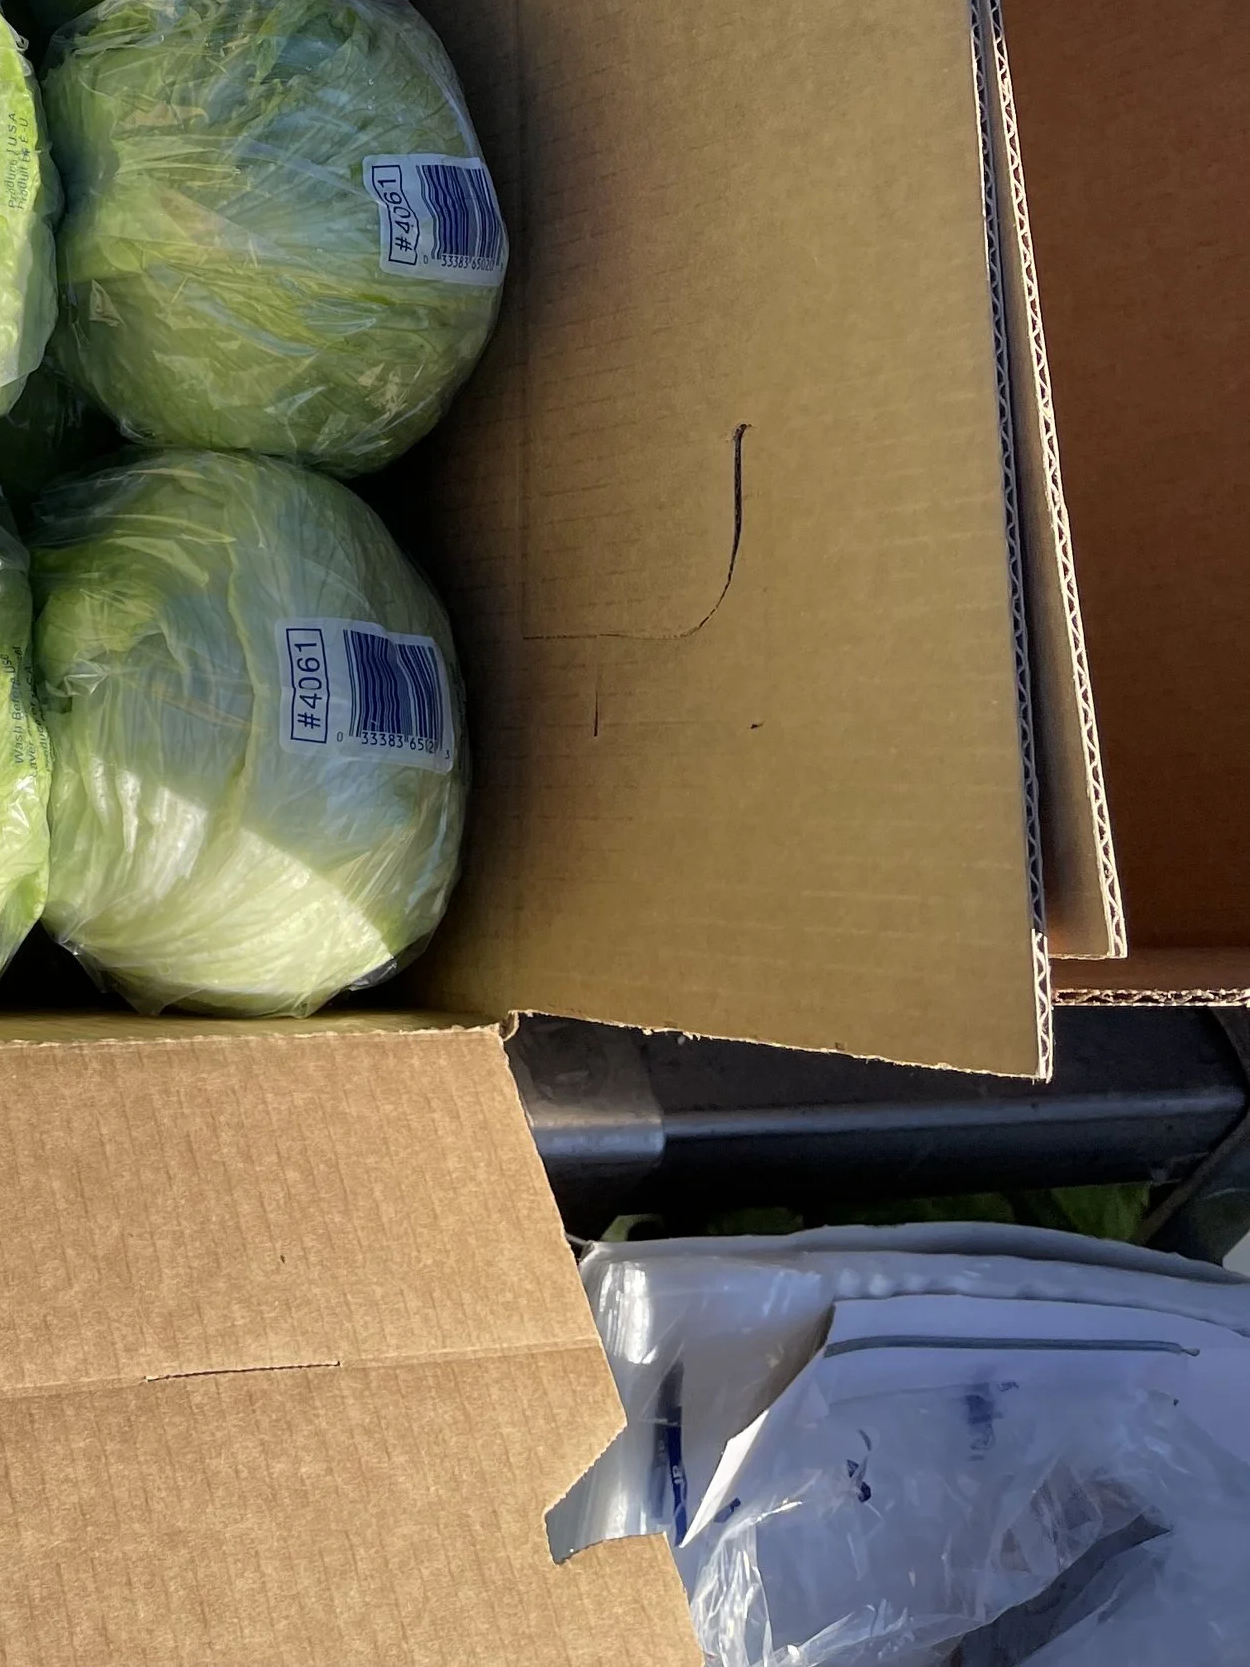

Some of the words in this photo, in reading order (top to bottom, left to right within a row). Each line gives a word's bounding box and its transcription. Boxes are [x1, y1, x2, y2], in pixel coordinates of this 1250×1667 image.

[17, 166, 28, 209] Produit
[377, 178, 411, 252] #4061
[424, 255, 428, 264] 0
[441, 255, 468, 268] 33383
[472, 256, 494, 271] 65020
[0, 653, 15, 674] Use
[10, 677, 22, 720] Before
[294, 642, 322, 729] #4061
[12, 725, 24, 764] Wash
[337, 732, 343, 742] 0
[362, 732, 403, 748] 33383
[445, 750, 450, 759] 3
